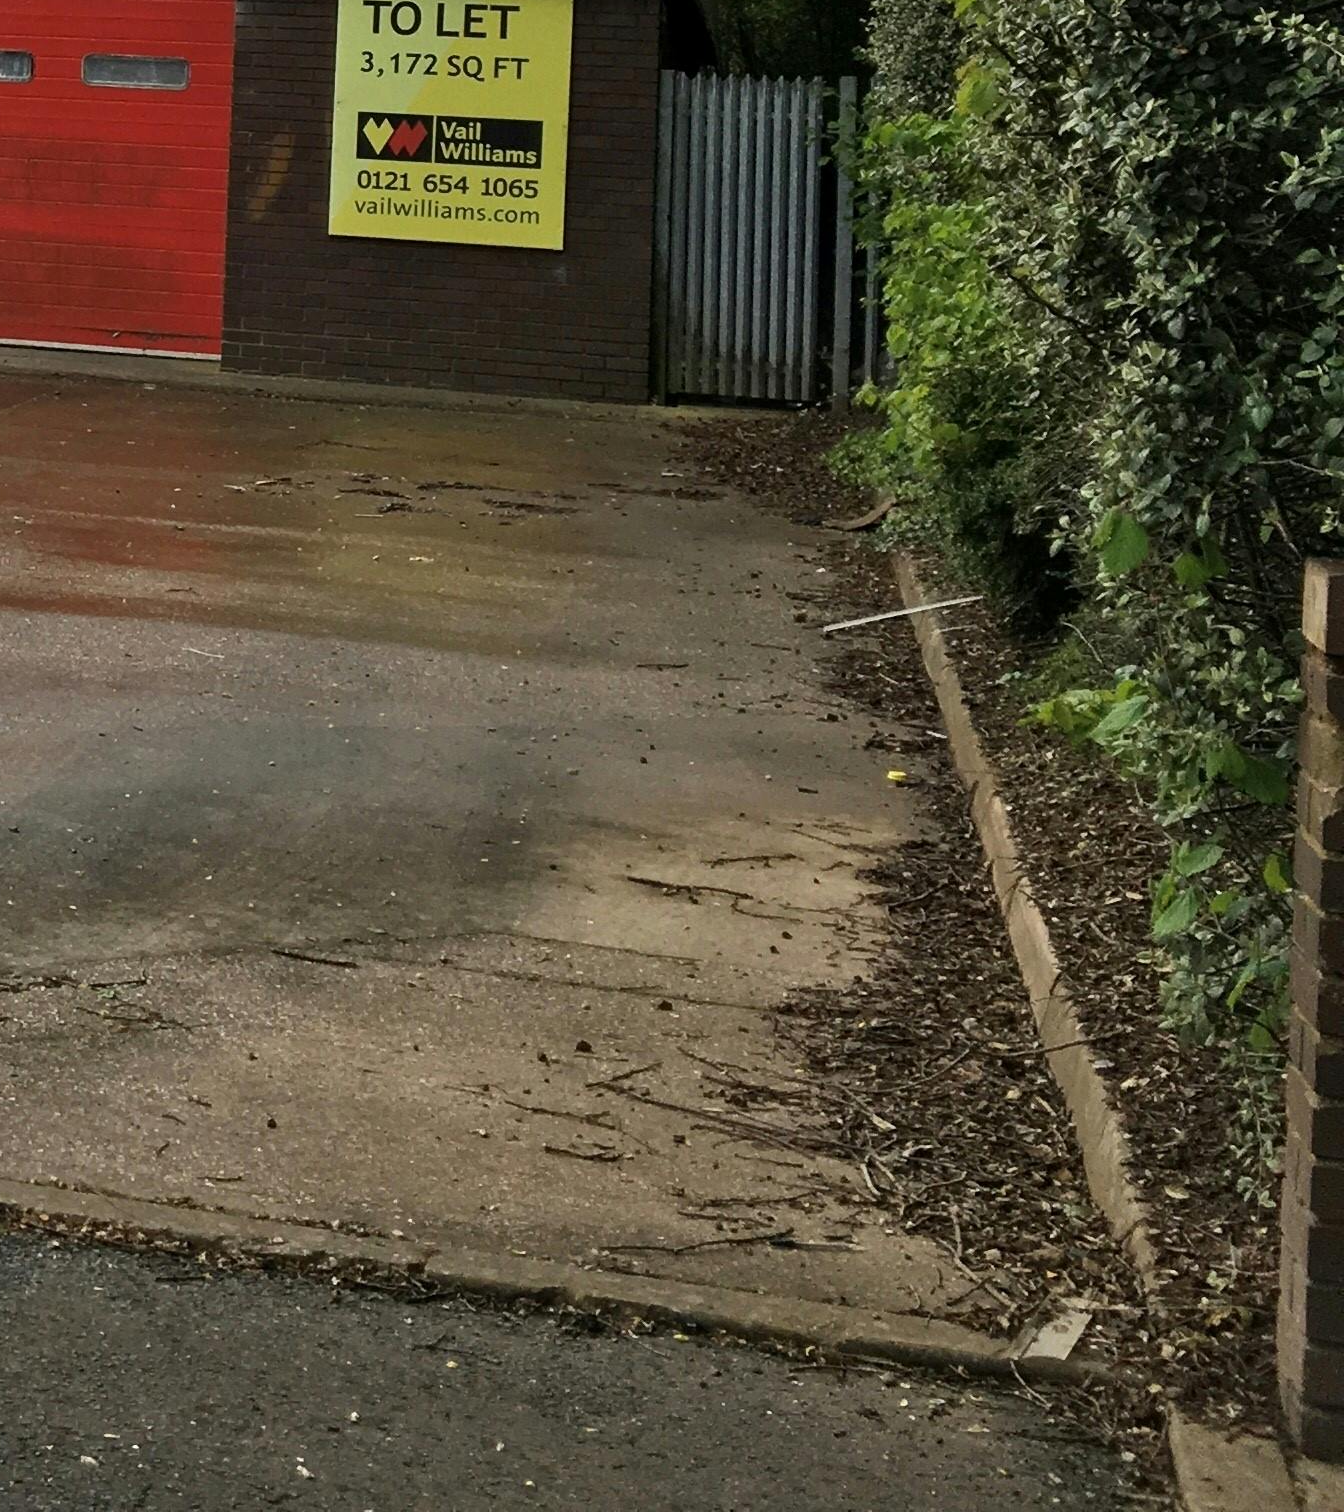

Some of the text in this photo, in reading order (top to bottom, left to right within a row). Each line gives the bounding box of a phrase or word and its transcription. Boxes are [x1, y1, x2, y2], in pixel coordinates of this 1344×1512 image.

[363, 0, 521, 40] TO LET
[360, 51, 530, 82] 3,172 SQ FT
[441, 120, 482, 141] Vail
[440, 141, 538, 165] Williams
[357, 170, 539, 199] 0121 654 1065
[354, 197, 541, 225] vailwilliams.com
